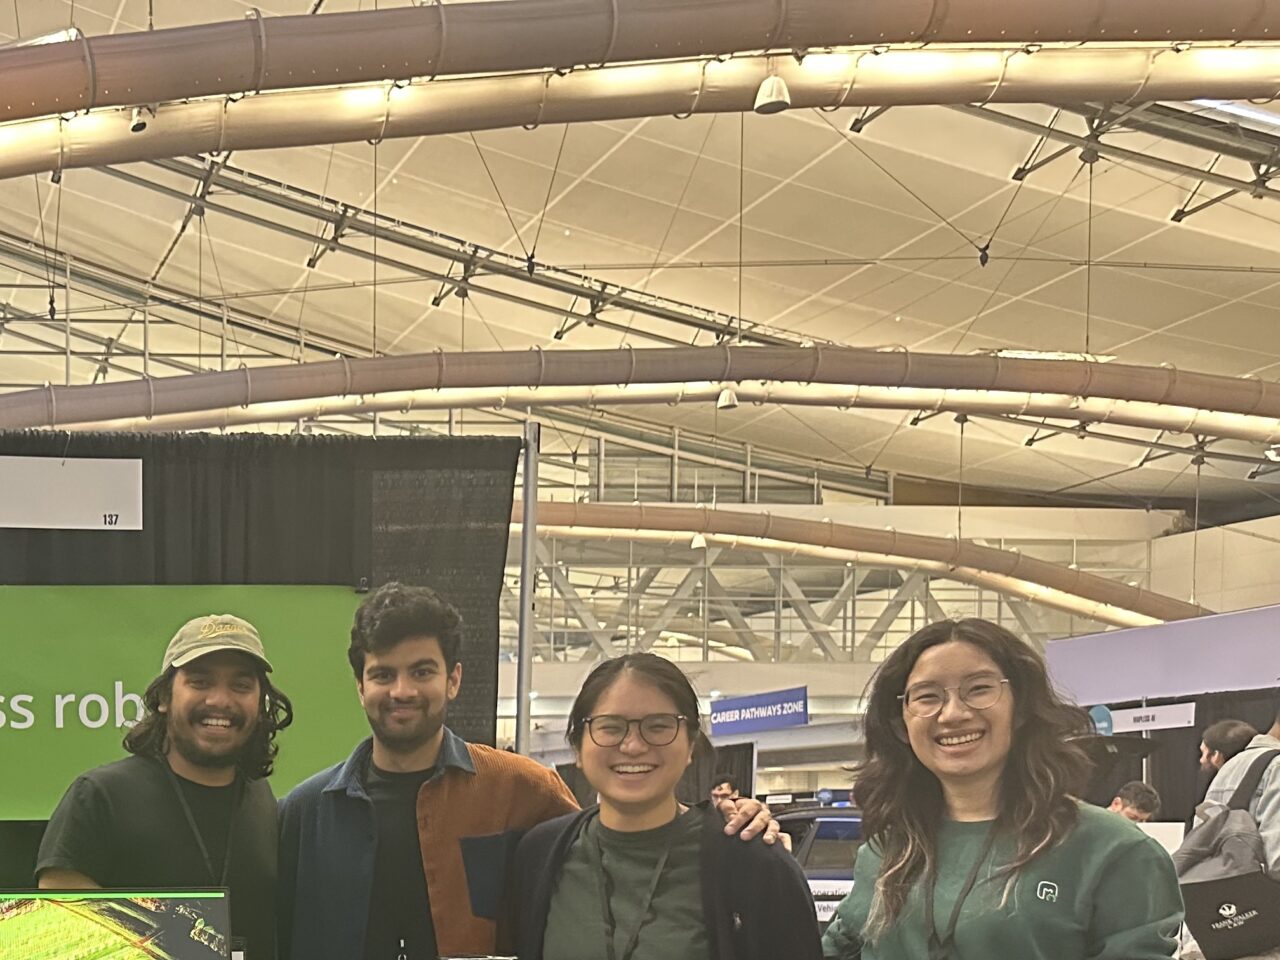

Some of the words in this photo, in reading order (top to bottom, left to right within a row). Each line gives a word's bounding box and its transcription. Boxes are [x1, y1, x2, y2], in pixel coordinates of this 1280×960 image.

[102, 514, 119, 526] 137
[55, 681, 145, 728] rob
[711, 710, 740, 724] CAREER
[741, 703, 782, 720] PATHWAYS
[782, 700, 804, 714] ZONE
